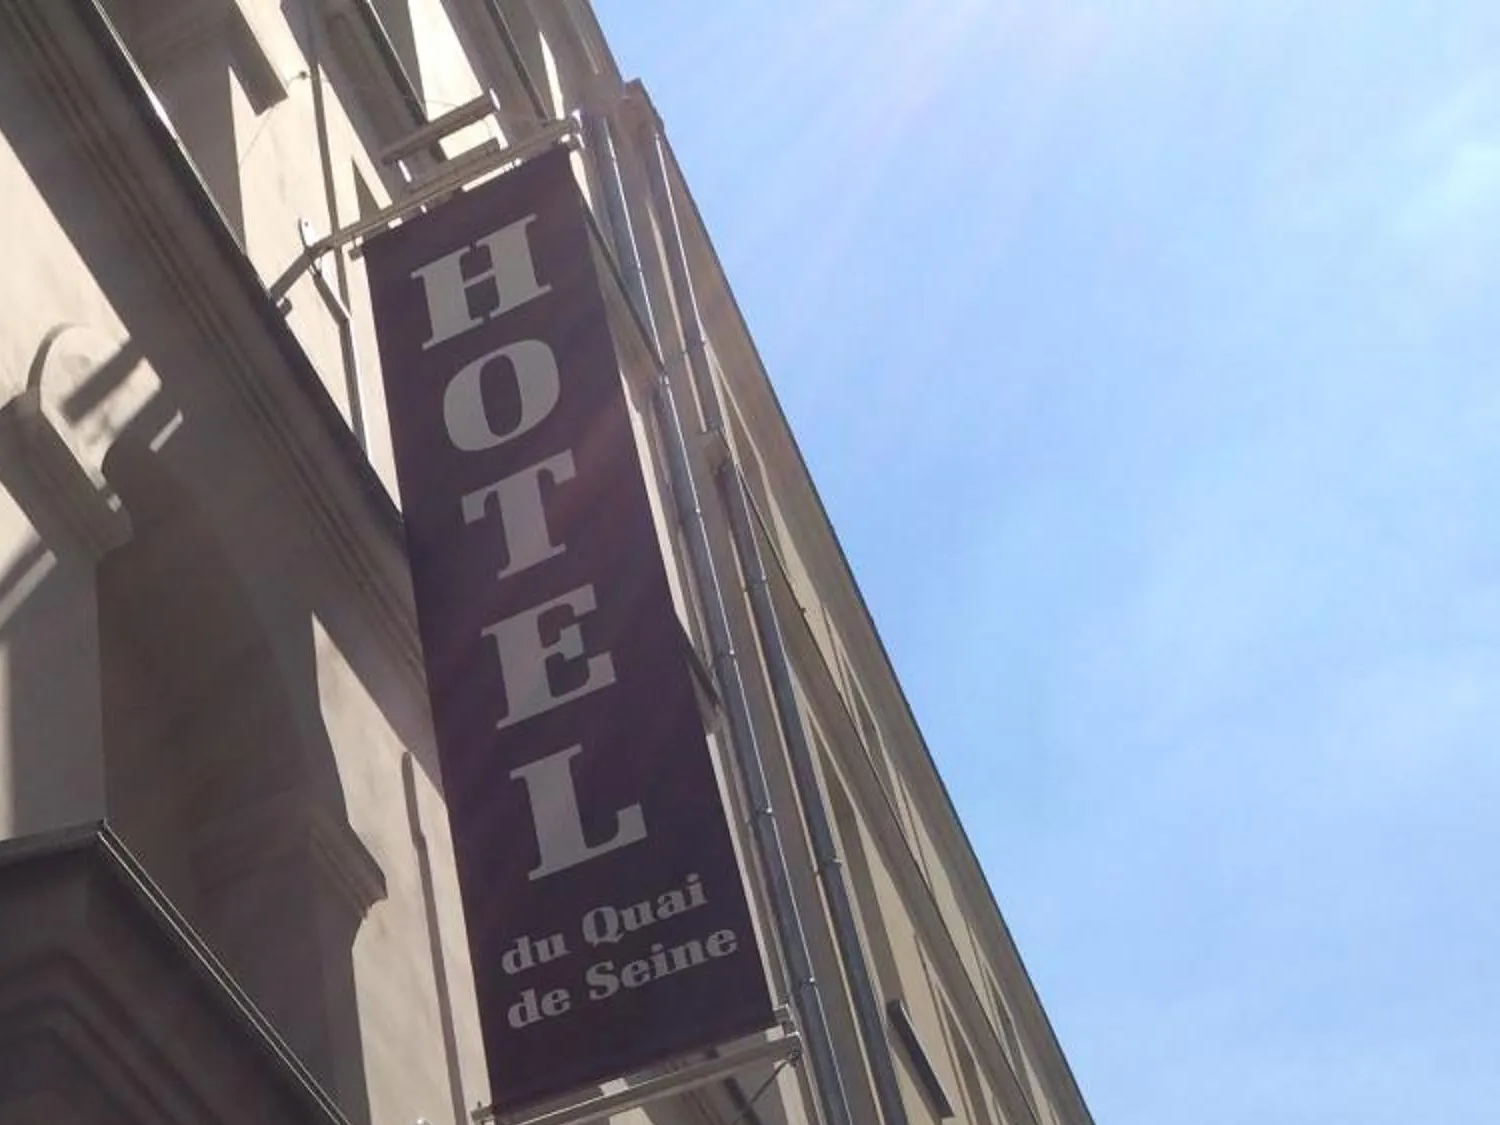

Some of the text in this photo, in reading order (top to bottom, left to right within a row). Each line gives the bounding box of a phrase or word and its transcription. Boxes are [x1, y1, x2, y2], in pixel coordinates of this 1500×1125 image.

[410, 213, 648, 881] HOTEL
[501, 873, 708, 976] du Quai
[507, 928, 739, 1029] de Seine
